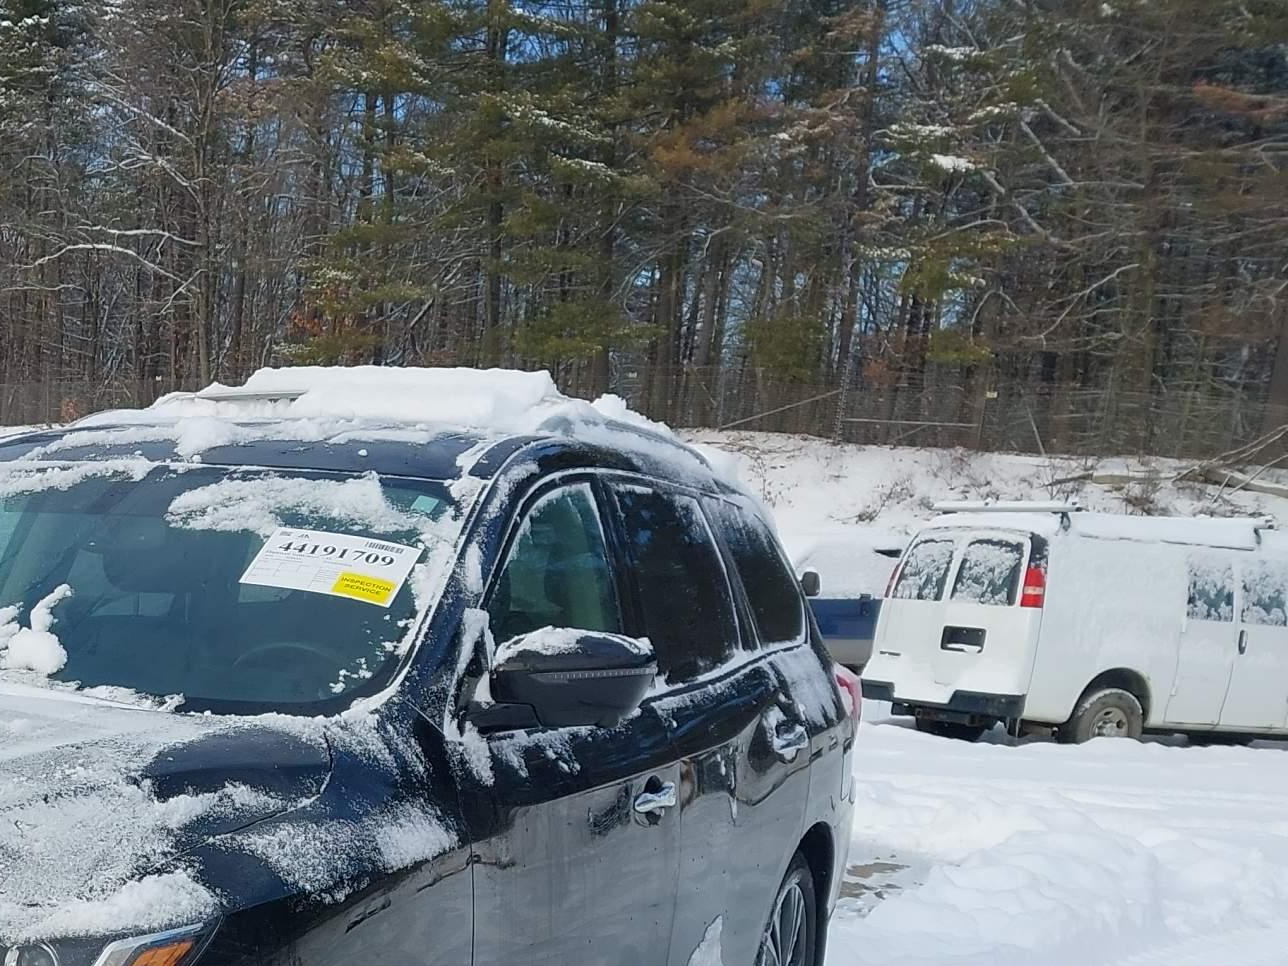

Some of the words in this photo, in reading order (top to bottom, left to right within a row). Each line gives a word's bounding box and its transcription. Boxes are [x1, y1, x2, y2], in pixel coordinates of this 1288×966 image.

[278, 541, 395, 567] 44191709
[341, 576, 392, 593] INSPECTION
[343, 583, 382, 596] SERVICE
